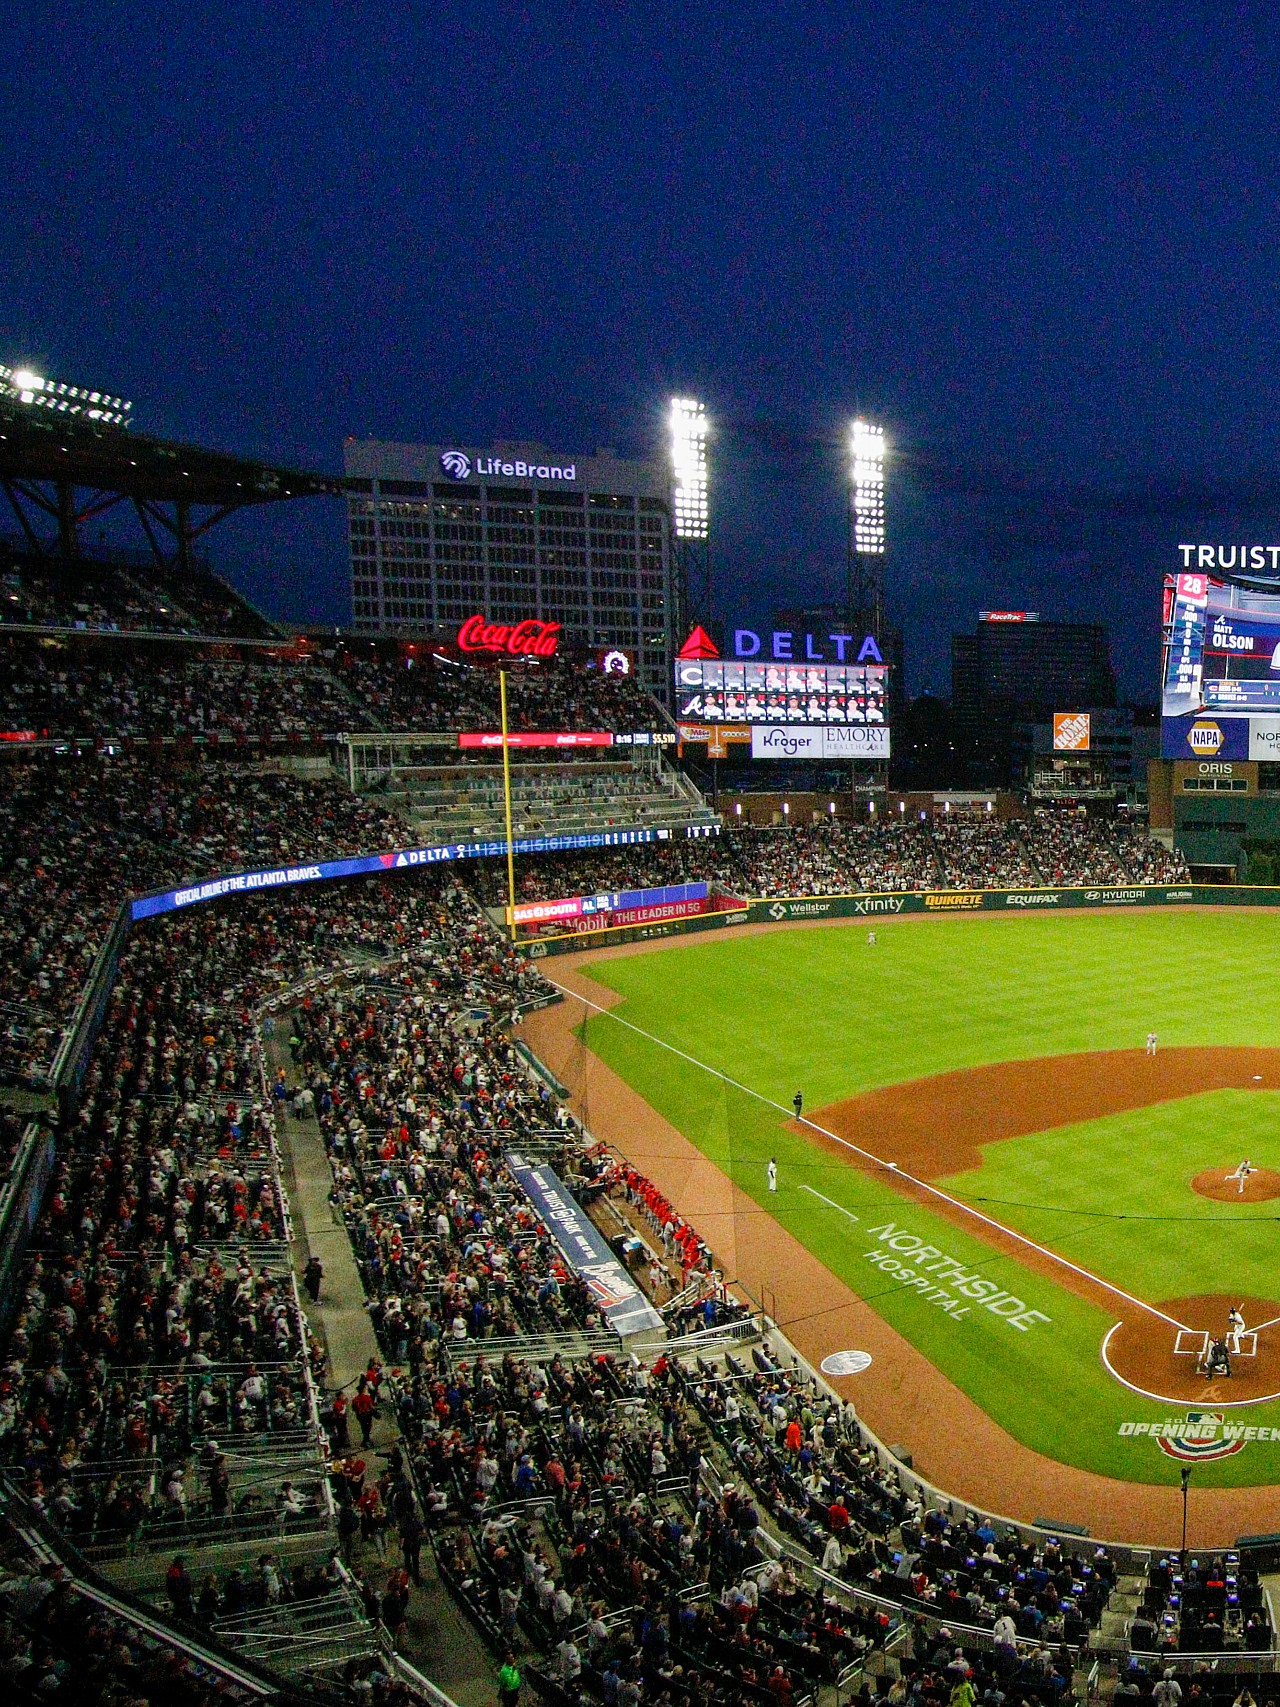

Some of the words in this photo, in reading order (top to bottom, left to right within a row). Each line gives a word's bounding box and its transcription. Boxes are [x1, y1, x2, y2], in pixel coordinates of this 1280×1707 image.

[477, 458, 576, 480] LifeBrand
[1183, 575, 1202, 594] 28
[1213, 625, 1233, 634] MATT
[734, 629, 883, 662] DELTA
[1212, 633, 1254, 650] OLSON
[763, 729, 812, 755] Kroger
[826, 728, 887, 742] EMORY
[1193, 731, 1219, 746] NAPA
[1199, 763, 1233, 774] ORIS
[410, 847, 449, 864] DELTA
[230, 876, 246, 890] THE
[246, 871, 287, 887] ATLANTA
[925, 894, 983, 906] QUIKRETE
[1006, 894, 1059, 906] EQUIFAX
[1102, 890, 1146, 899] HYUNDAI
[544, 903, 577, 915] SOUTH
[582, 900, 596, 911] AL
[616, 912, 636, 923] THE
[637, 905, 676, 920] LEADER
[676, 903, 686, 915] IN
[688, 902, 700, 913] 5G
[790, 903, 830, 912] Wellstar
[854, 896, 905, 914] xfinity
[559, 1216, 583, 1235] PARK
[863, 1249, 971, 1322] HOSPITAL
[867, 1222, 1053, 1332] NORTHSIDE
[1116, 1422, 1218, 1439] OPENING
